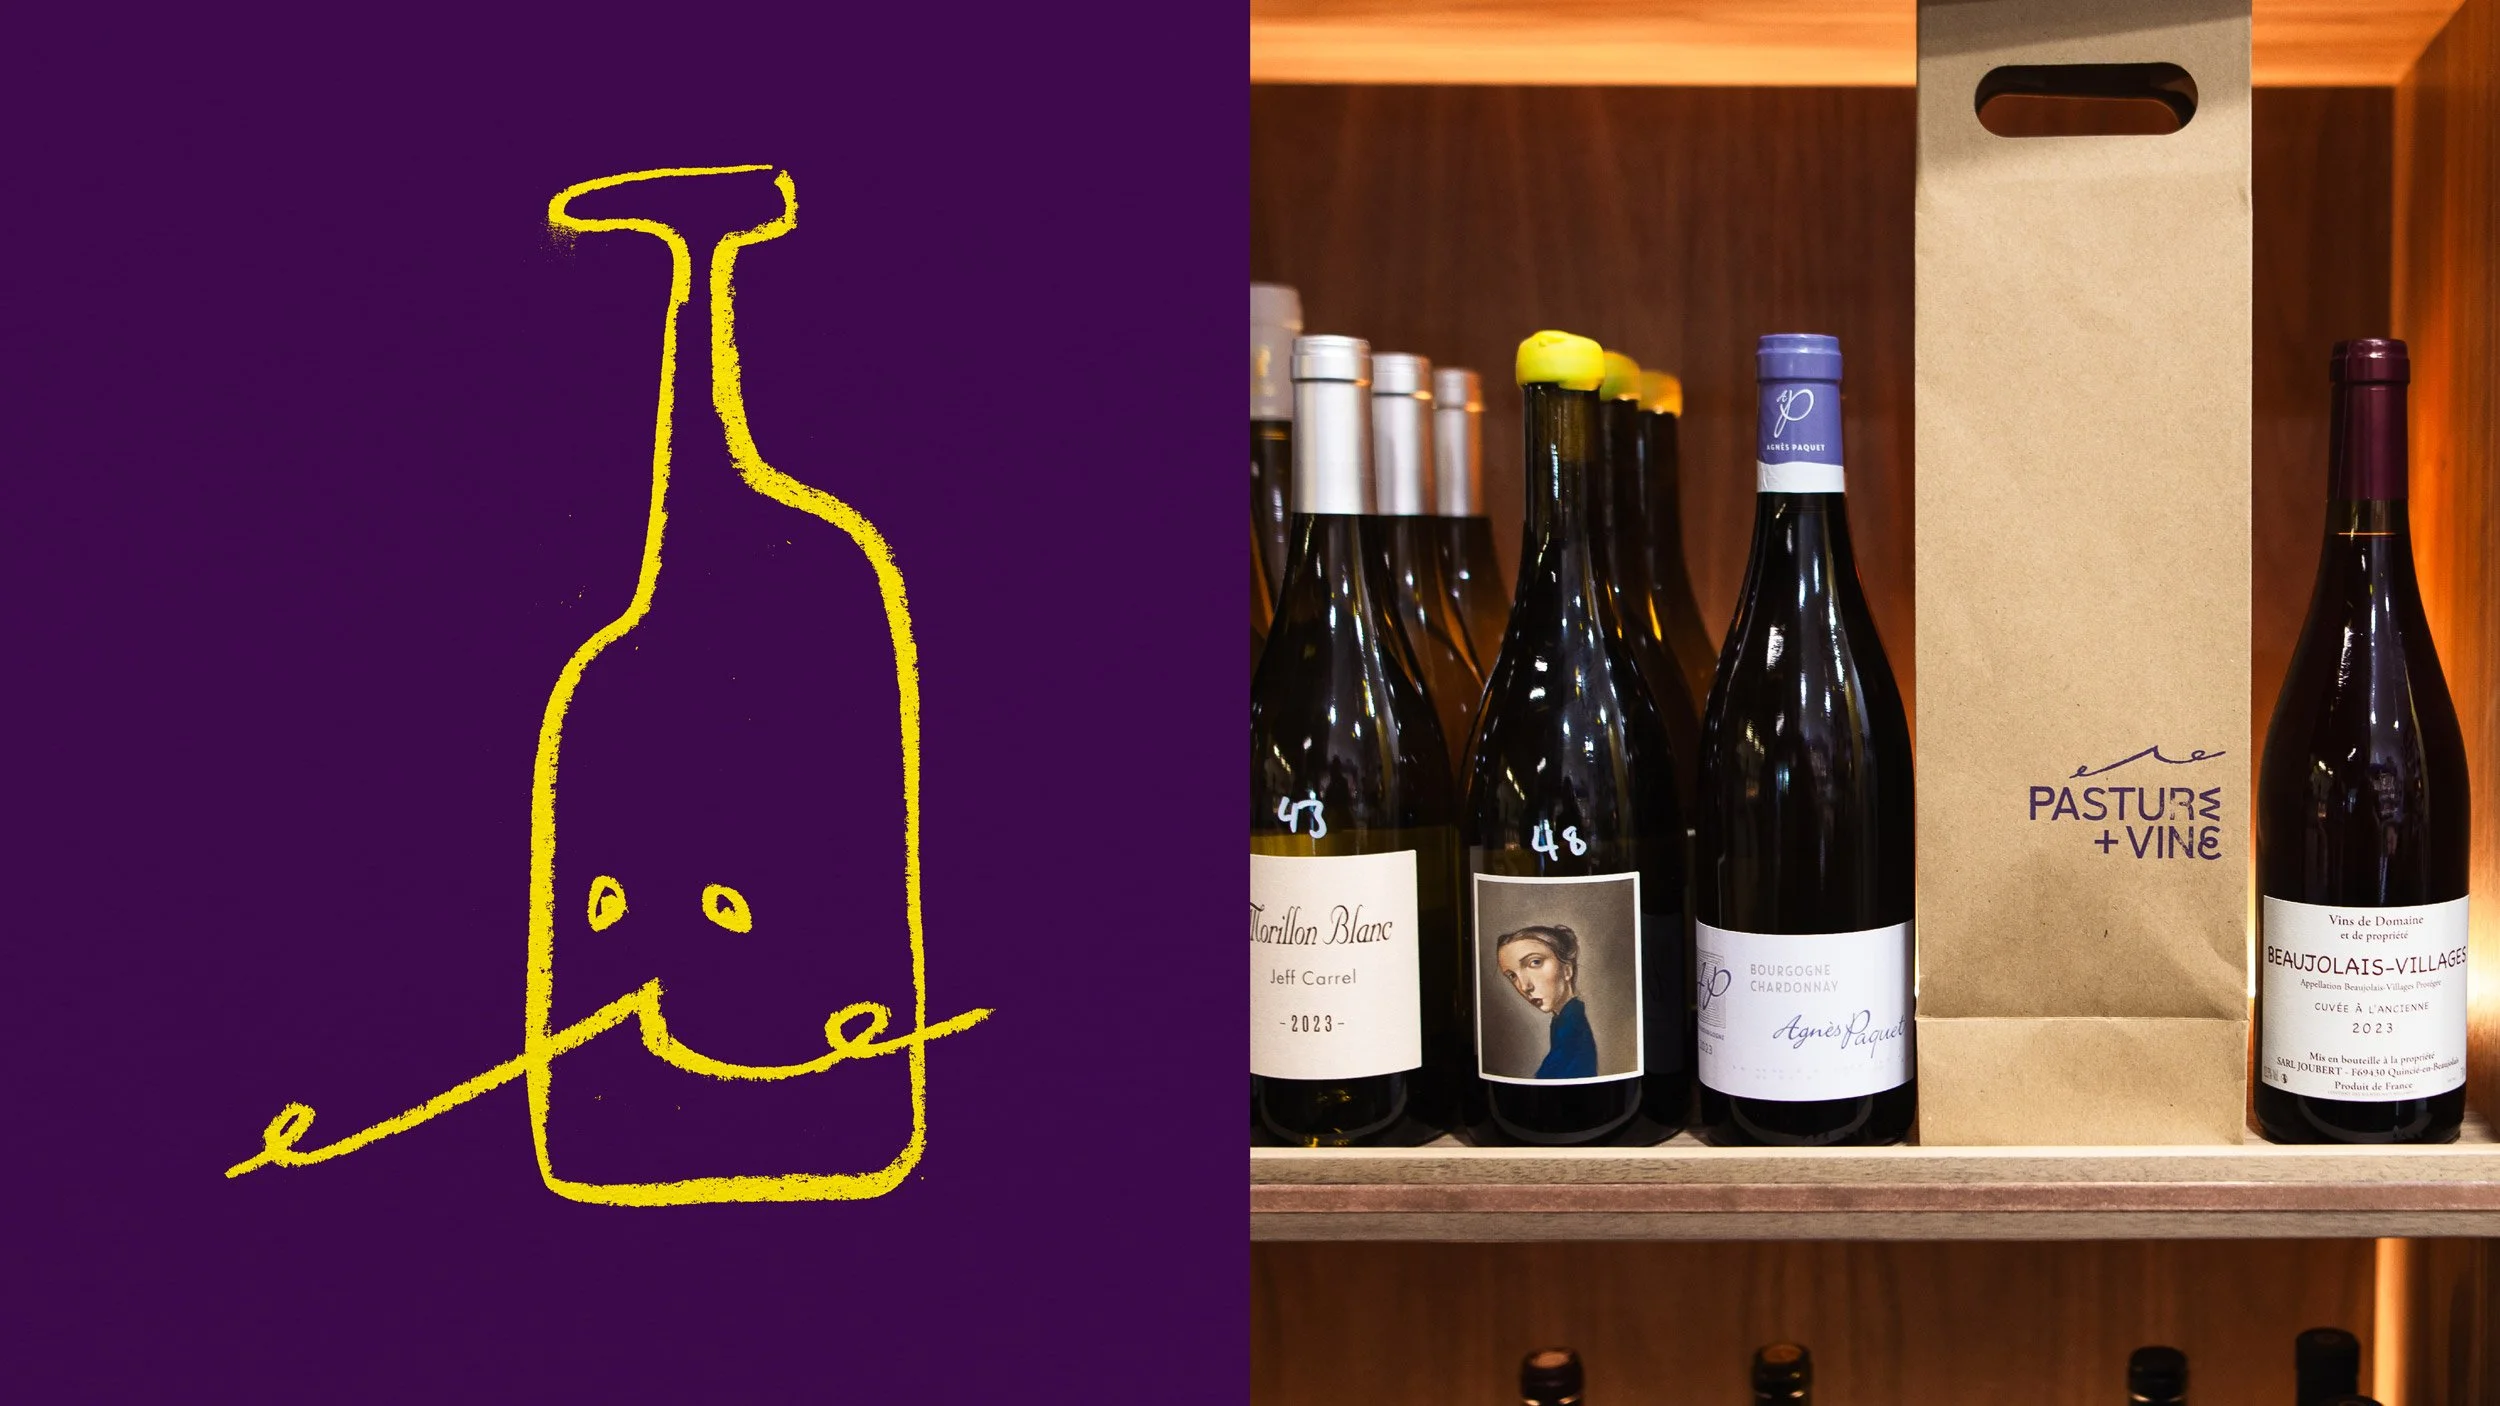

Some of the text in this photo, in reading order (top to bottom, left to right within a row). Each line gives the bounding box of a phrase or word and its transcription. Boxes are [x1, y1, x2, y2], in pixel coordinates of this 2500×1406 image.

[1766, 443, 1825, 452] AGNÈS PAQUET
[2029, 786, 2221, 821] PASTURE
[1278, 796, 1327, 839] 43
[1531, 819, 1587, 861] 48
[1323, 904, 1393, 945] Blanc
[2329, 914, 2424, 927] Vins de Domaine
[2340, 931, 2408, 943] et de propriété
[2268, 945, 2466, 976] BEAUJOLAIS-VILLAGES
[1750, 964, 1830, 976] BOURGOGNE
[1270, 969, 1357, 985] Jeff Carrel
[1750, 980, 1838, 993] CHARDONNAY
[2300, 978, 2342, 991] Appellation
[2314, 1001, 2429, 1014] CUVÉE À L'ANCIENNE
[1772, 1009, 1906, 1058] Agnès Paquet
[2352, 1022, 2394, 1034] 2023
[2309, 1051, 2326, 1062] Mis
[2341, 1055, 2381, 1065] bouteille
[2391, 1055, 2398, 1064] la
[2277, 1056, 2296, 1069] SARL
[2296, 1062, 2342, 1075] JOUBERT
[2334, 1081, 2413, 1091] Produit de France
